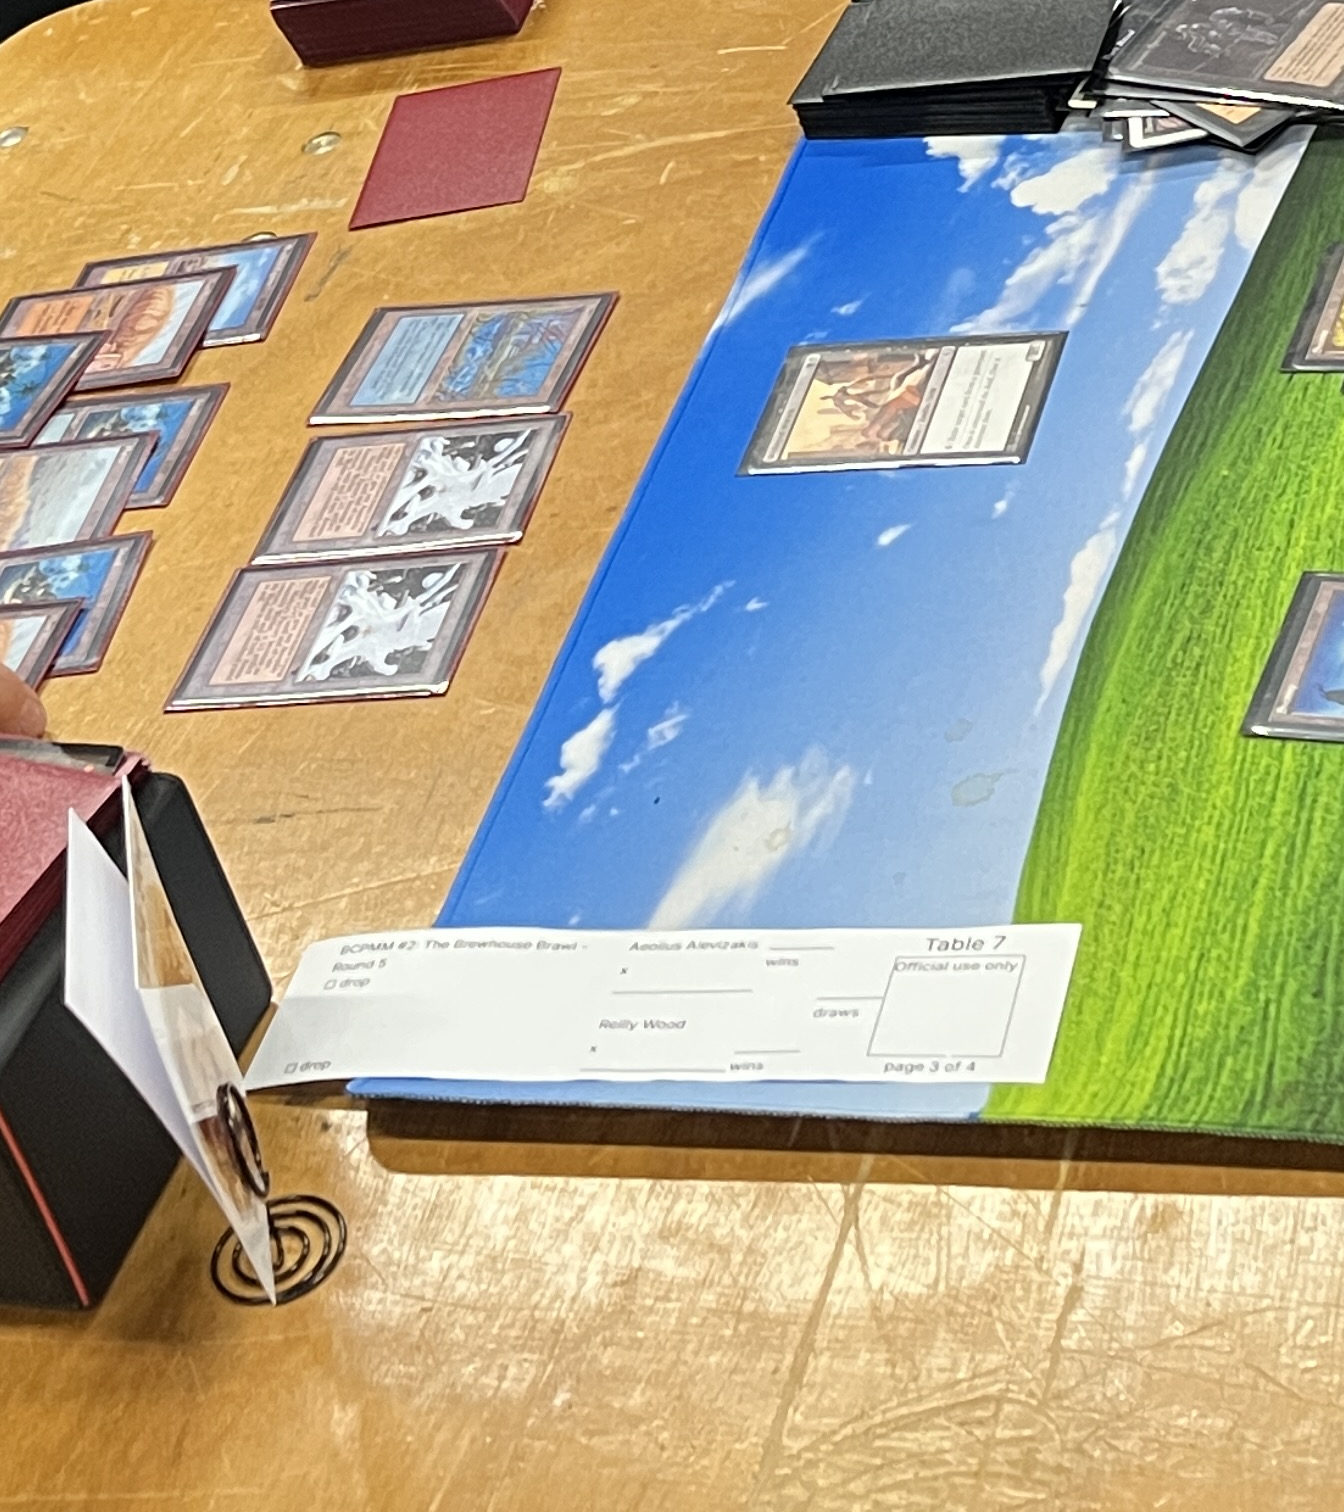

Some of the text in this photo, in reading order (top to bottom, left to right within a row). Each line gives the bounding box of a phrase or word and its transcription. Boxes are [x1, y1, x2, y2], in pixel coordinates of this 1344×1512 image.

[425, 939, 450, 951] The
[926, 935, 1007, 952] Table 7
[332, 959, 376, 973] Round
[765, 958, 799, 968] wins
[894, 961, 1019, 974] Official use only
[339, 977, 372, 990] drop
[812, 1007, 861, 1019] draws
[643, 1019, 687, 1030] Wood
[299, 1059, 332, 1073] drop
[883, 1060, 976, 1074] page 3 of 4
